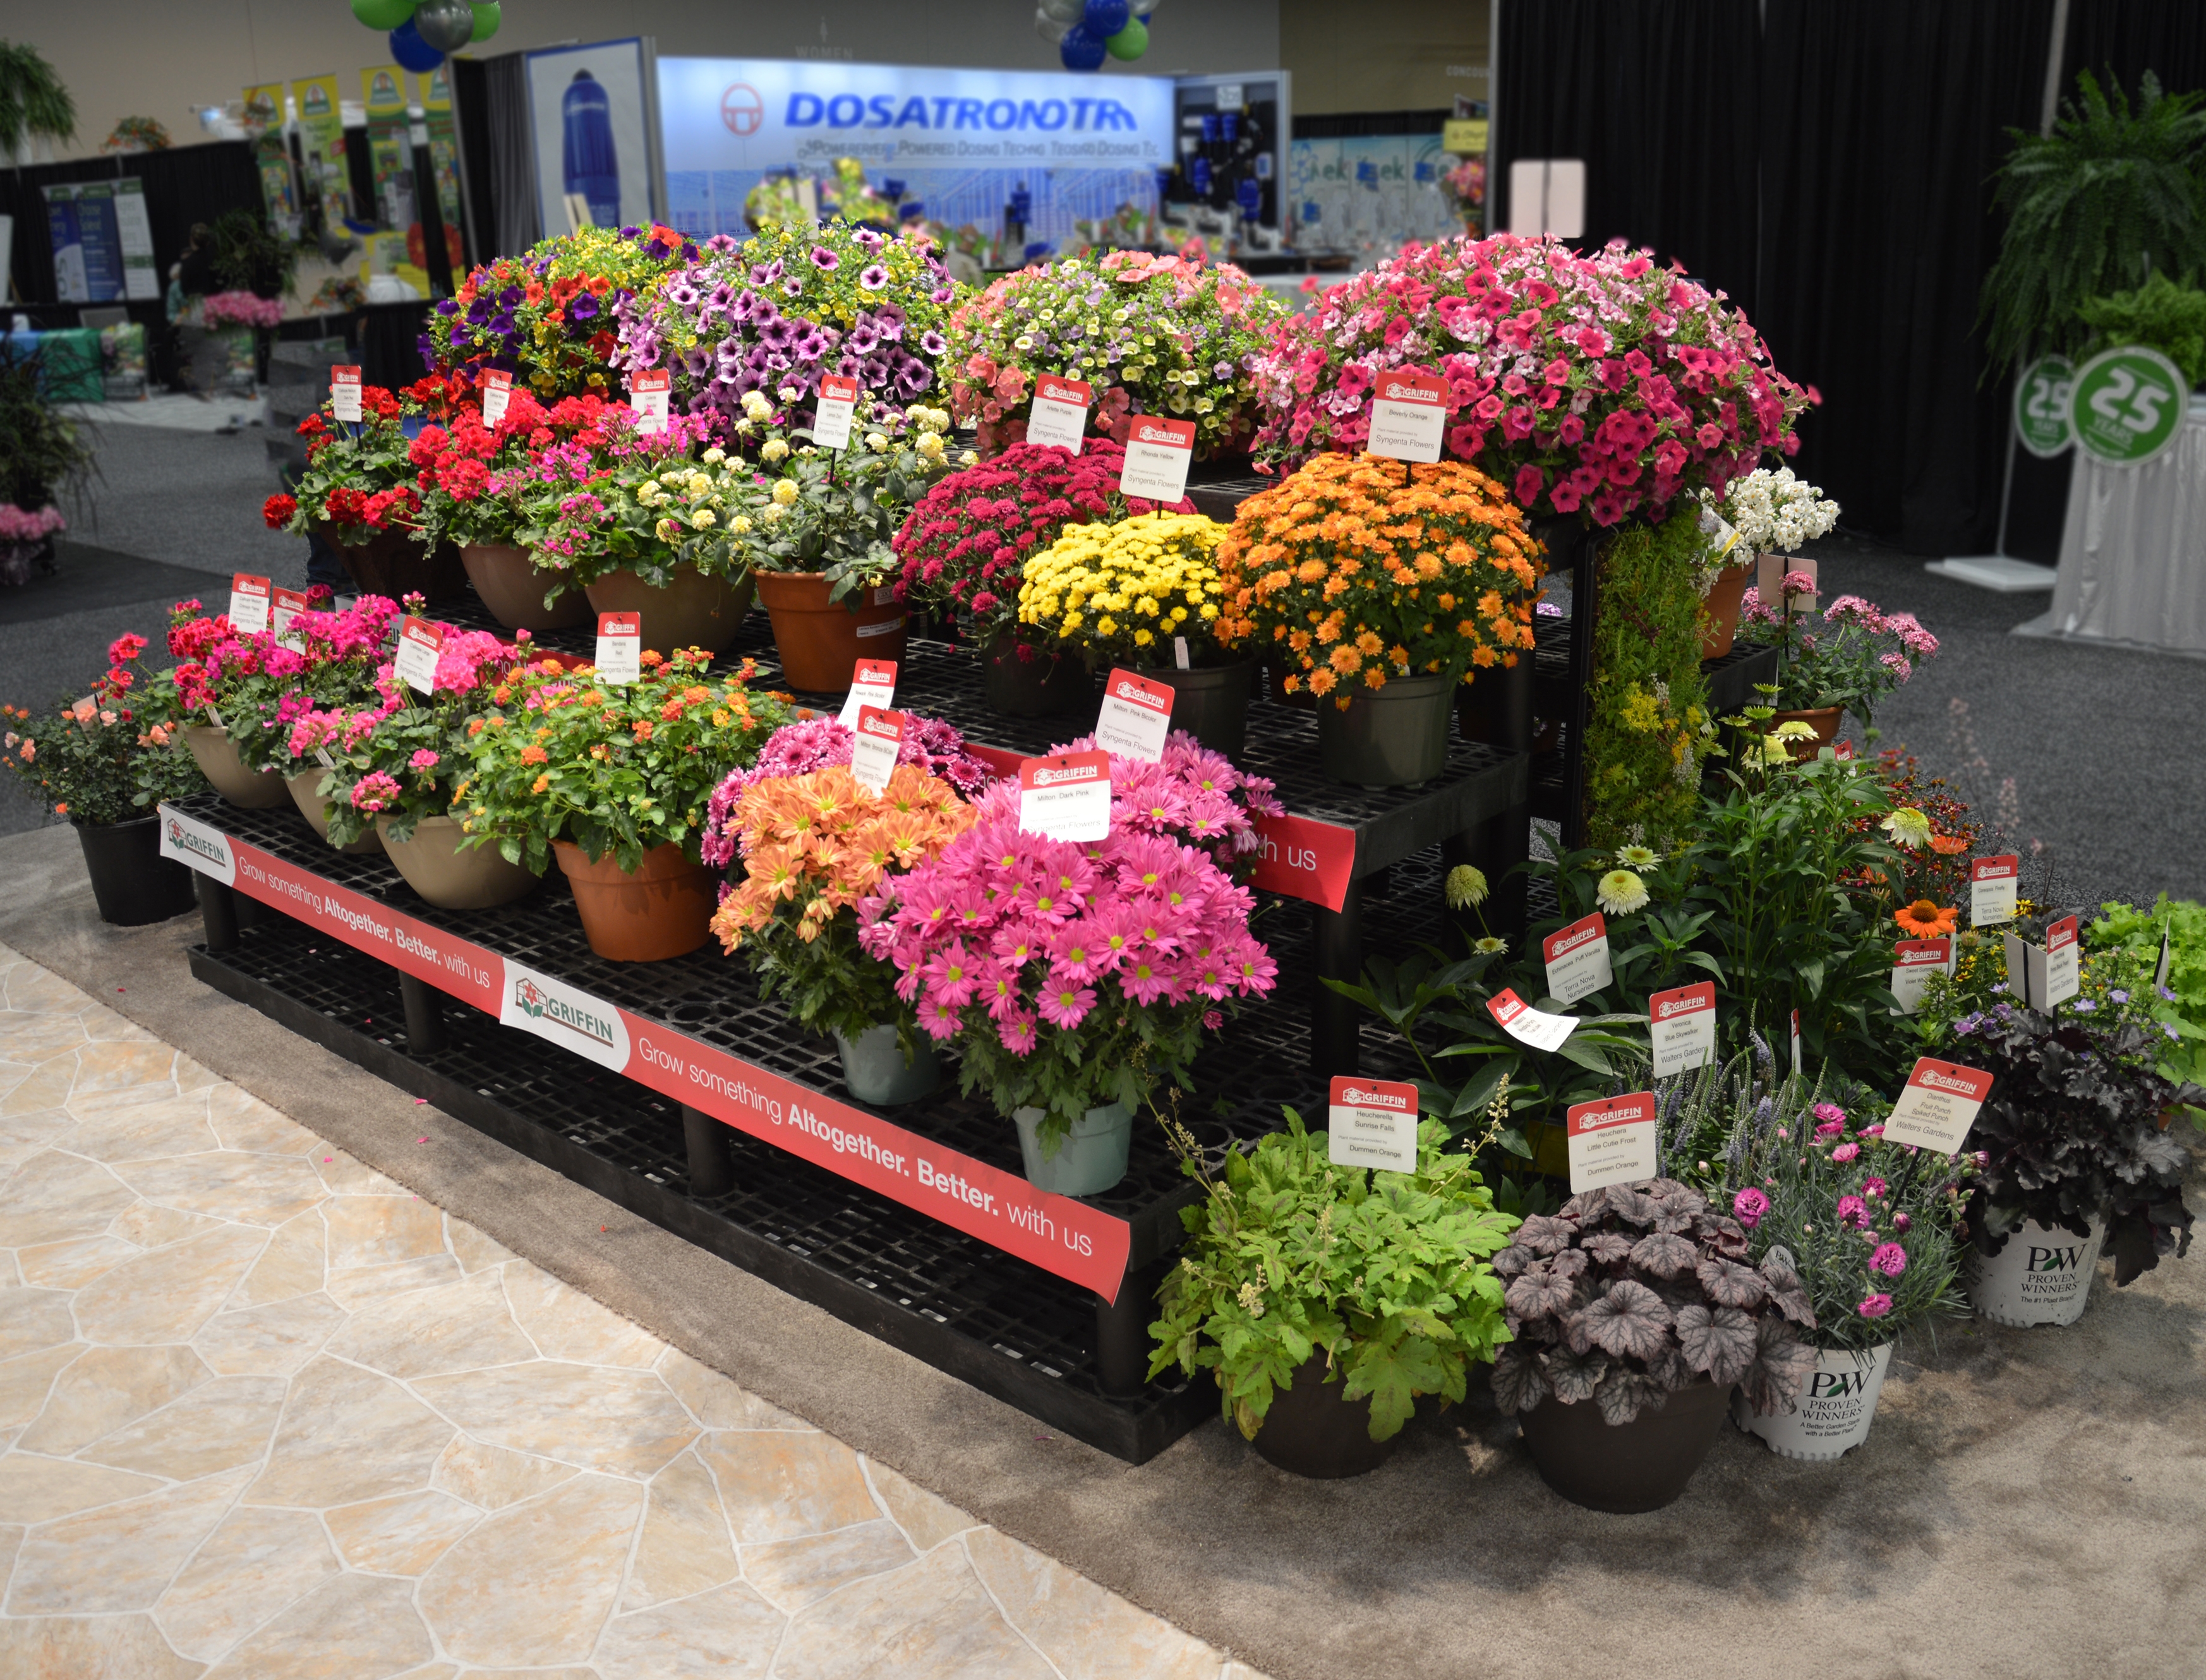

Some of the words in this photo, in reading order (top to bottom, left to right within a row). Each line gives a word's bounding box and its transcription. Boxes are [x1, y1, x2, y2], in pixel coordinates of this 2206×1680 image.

[796, 45, 852, 59] WOMEN
[1058, 389, 1083, 400] GRIFFIN
[1405, 388, 1438, 399] GRIFFIN
[2089, 366, 2172, 433] 25
[1389, 409, 1407, 418] Beverly
[817, 427, 834, 435] Syngenta
[1034, 428, 1058, 439] Syngenta
[1059, 433, 1077, 443] Flowers
[1156, 431, 1186, 441] GRIFFIN
[2094, 414, 2135, 446] YEARS
[1376, 435, 1407, 445] Syngenta
[1409, 439, 1435, 449] Flowers
[1128, 474, 1155, 485] Syngenta
[1157, 479, 1179, 489] Flowers
[419, 632, 438, 645] GRIFFIN
[399, 664, 418, 677] Syngenta
[870, 672, 890, 680] GRIFFIN
[1135, 690, 1165, 706] GRIFFIN
[1113, 704, 1128, 712] Milton
[1142, 713, 1157, 723] Bicolor
[876, 721, 898, 735] GRIFFIN
[1102, 731, 1131, 747] Syngenta
[1133, 741, 1156, 756] Flowers
[855, 767, 874, 781] Syngenta
[1056, 765, 1097, 778] GRIFFIN
[1028, 824, 1066, 832] Syngenta
[186, 834, 225, 863] GRIFFIN
[1288, 846, 1316, 871] us
[239, 856, 266, 884] Grow
[268, 876, 322, 915] something
[325, 896, 393, 944] Altogether.
[395, 927, 442, 966] Better.
[443, 954, 471, 980] with
[474, 966, 490, 988] us
[1566, 927, 1596, 946] GRIFFIN
[2055, 929, 2071, 944] GRIFFIN
[1552, 961, 1574, 975] Echinacea
[1584, 948, 1600, 957] Vanilla
[1564, 983, 1579, 992] Terra
[1580, 975, 1595, 985] Nova
[2060, 978, 2074, 988] Gardens
[1567, 983, 1594, 999] Nurseries
[1504, 1000, 1519, 1014] GRIFFIN
[1674, 996, 1705, 1009] GRIFFIN
[548, 998, 613, 1041] GRIFFIN
[1672, 1020, 1691, 1028] Veronica
[1676, 1028, 1698, 1038] Skywalker
[1661, 1053, 1682, 1064] Walters
[1939, 1076, 1977, 1092] GRIFFIN
[1365, 1093, 1406, 1105] GRIFFIN
[1927, 1093, 1951, 1104] Dianthus
[1356, 1111, 1393, 1120] Heucherella
[1600, 1107, 1642, 1121] GRIFFIN
[1912, 1108, 1930, 1118] Spiked
[1931, 1113, 1948, 1122] Punch
[1920, 1102, 1933, 1110] Fruit
[1934, 1105, 1951, 1115] Punch
[1355, 1121, 1378, 1129] Sunrise
[1896, 1120, 1921, 1132] Walters
[1923, 1126, 1954, 1140] Gardens
[1597, 1128, 1627, 1138] Heuchera
[639, 1037, 684, 1076] Grow
[689, 1064, 782, 1125] something
[788, 1103, 910, 1177] Altogether.
[918, 1158, 999, 1216] Better.
[1007, 1201, 1055, 1240] with
[1064, 1227, 1093, 1257] us
[1349, 1144, 1377, 1154] Dummen
[1379, 1149, 1401, 1158] Orange
[1587, 1143, 1601, 1151] Little
[1588, 1165, 1614, 1176] Dummen
[1615, 1161, 1639, 1170] Orange
[2028, 1272, 2076, 1284] PROVEN
[2021, 1281, 2078, 1293] WINNERS
[1809, 1396, 1862, 1410] PROVEN
[1802, 1405, 1862, 1421] WINNERS
[1847, 1418, 1860, 1426] Starts
